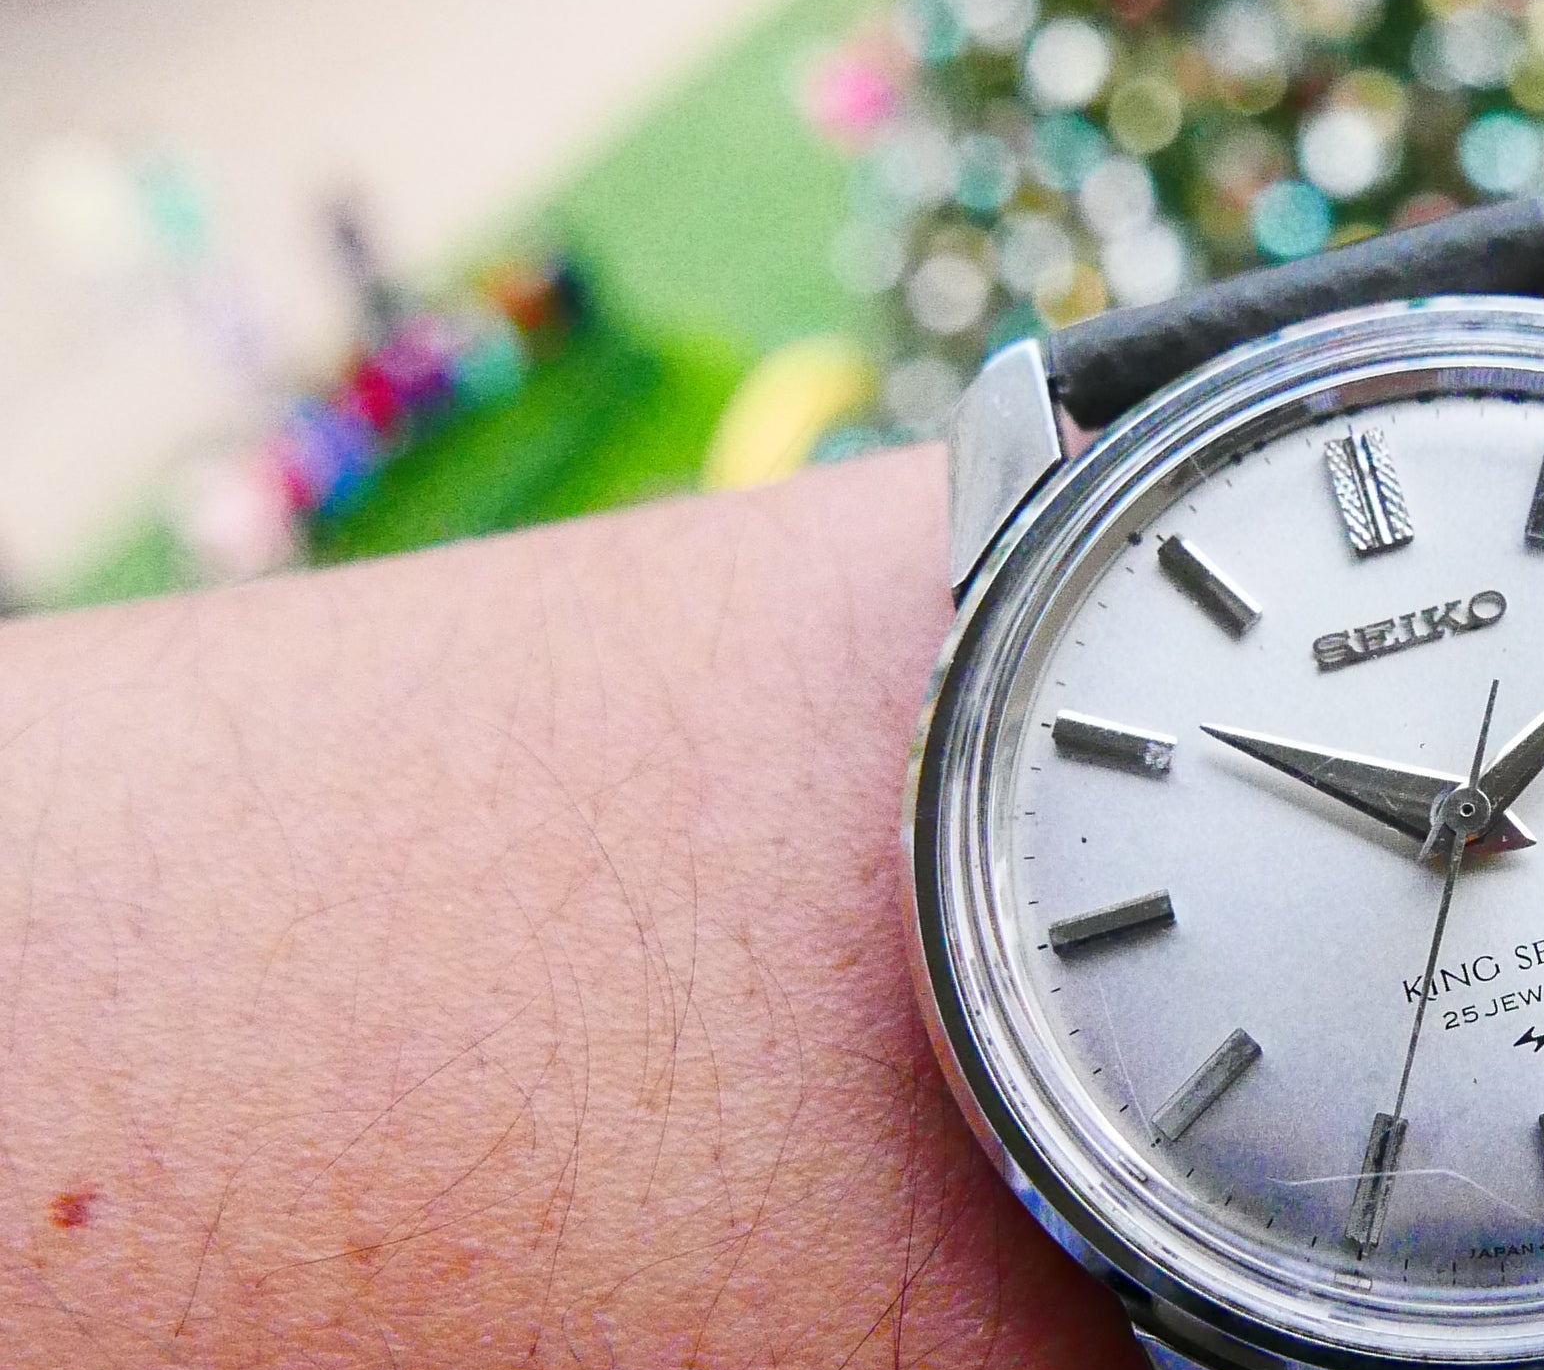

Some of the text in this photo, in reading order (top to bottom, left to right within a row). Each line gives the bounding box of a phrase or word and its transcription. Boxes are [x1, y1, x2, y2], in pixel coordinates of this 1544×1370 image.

[1312, 590, 1507, 673] SEIKO
[1403, 955, 1500, 1003] KING
[1443, 1005, 1479, 1030] 25
[1469, 1242, 1533, 1259] JAPAN
